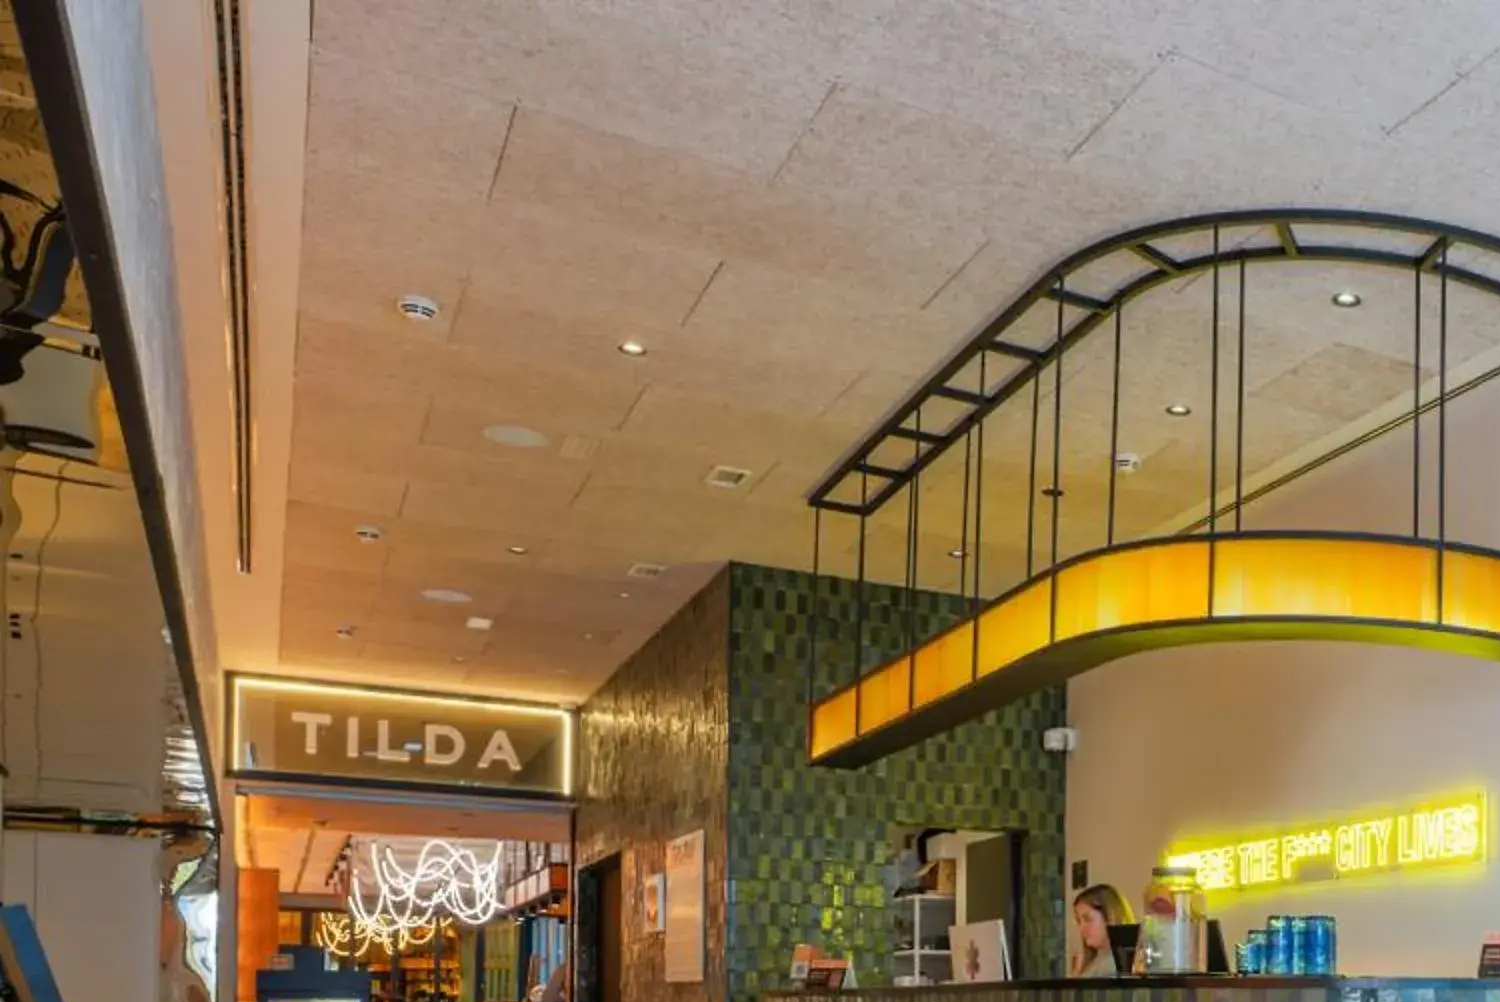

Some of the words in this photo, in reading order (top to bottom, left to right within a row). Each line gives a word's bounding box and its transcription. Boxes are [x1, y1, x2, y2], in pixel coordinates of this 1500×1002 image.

[291, 711, 522, 771] TILDA
[1237, 837, 1280, 885] THE
[1335, 815, 1393, 872] CITY
[1397, 803, 1479, 863] LIVES
